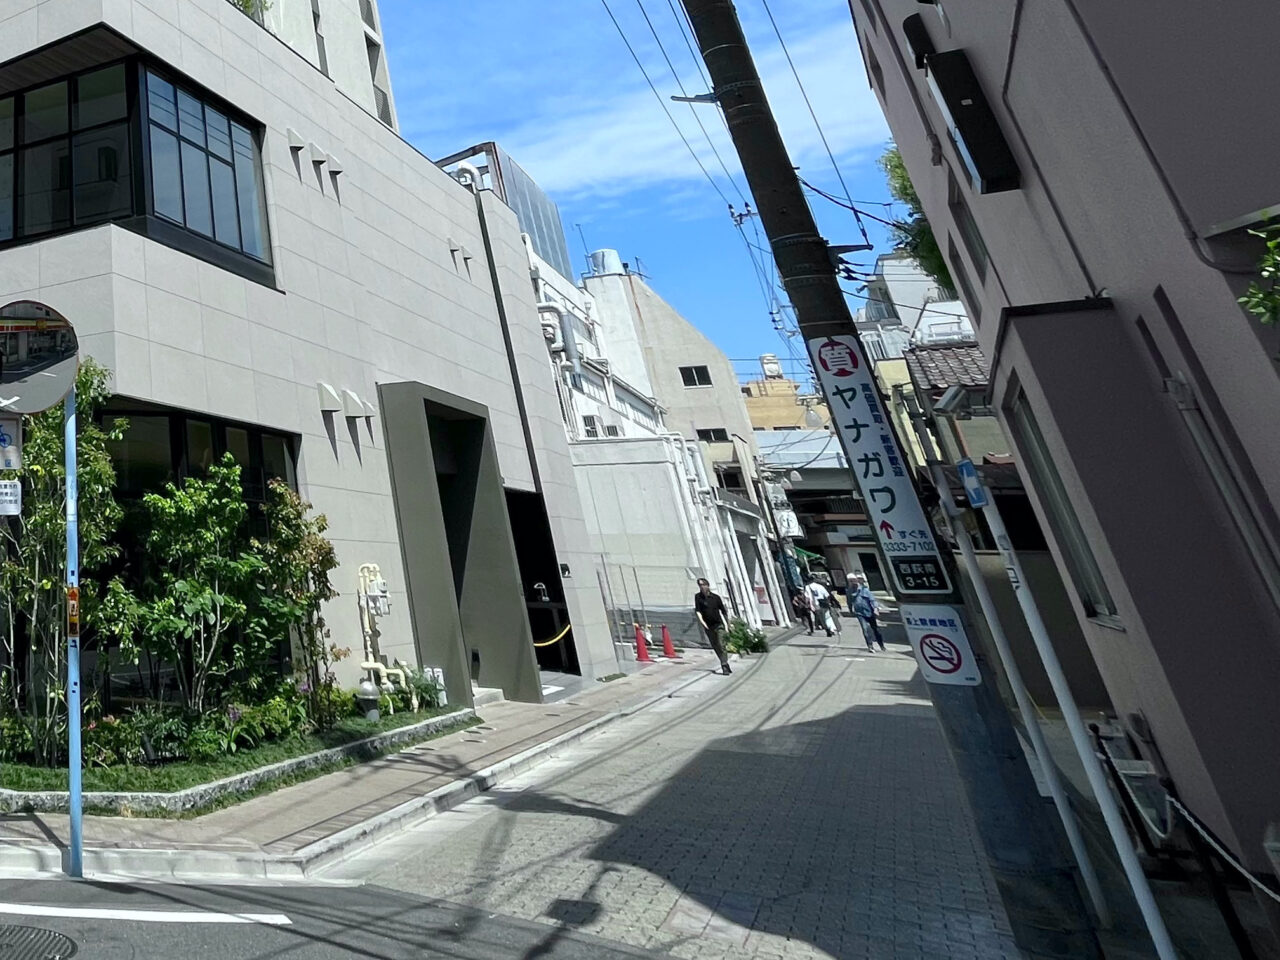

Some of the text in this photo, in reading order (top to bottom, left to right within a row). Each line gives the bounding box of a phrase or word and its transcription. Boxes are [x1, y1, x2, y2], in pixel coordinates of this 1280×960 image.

[832, 385, 896, 513] ヤナガワ
[883, 542, 937, 552] 3333-7102
[905, 576, 940, 587] 3-15
